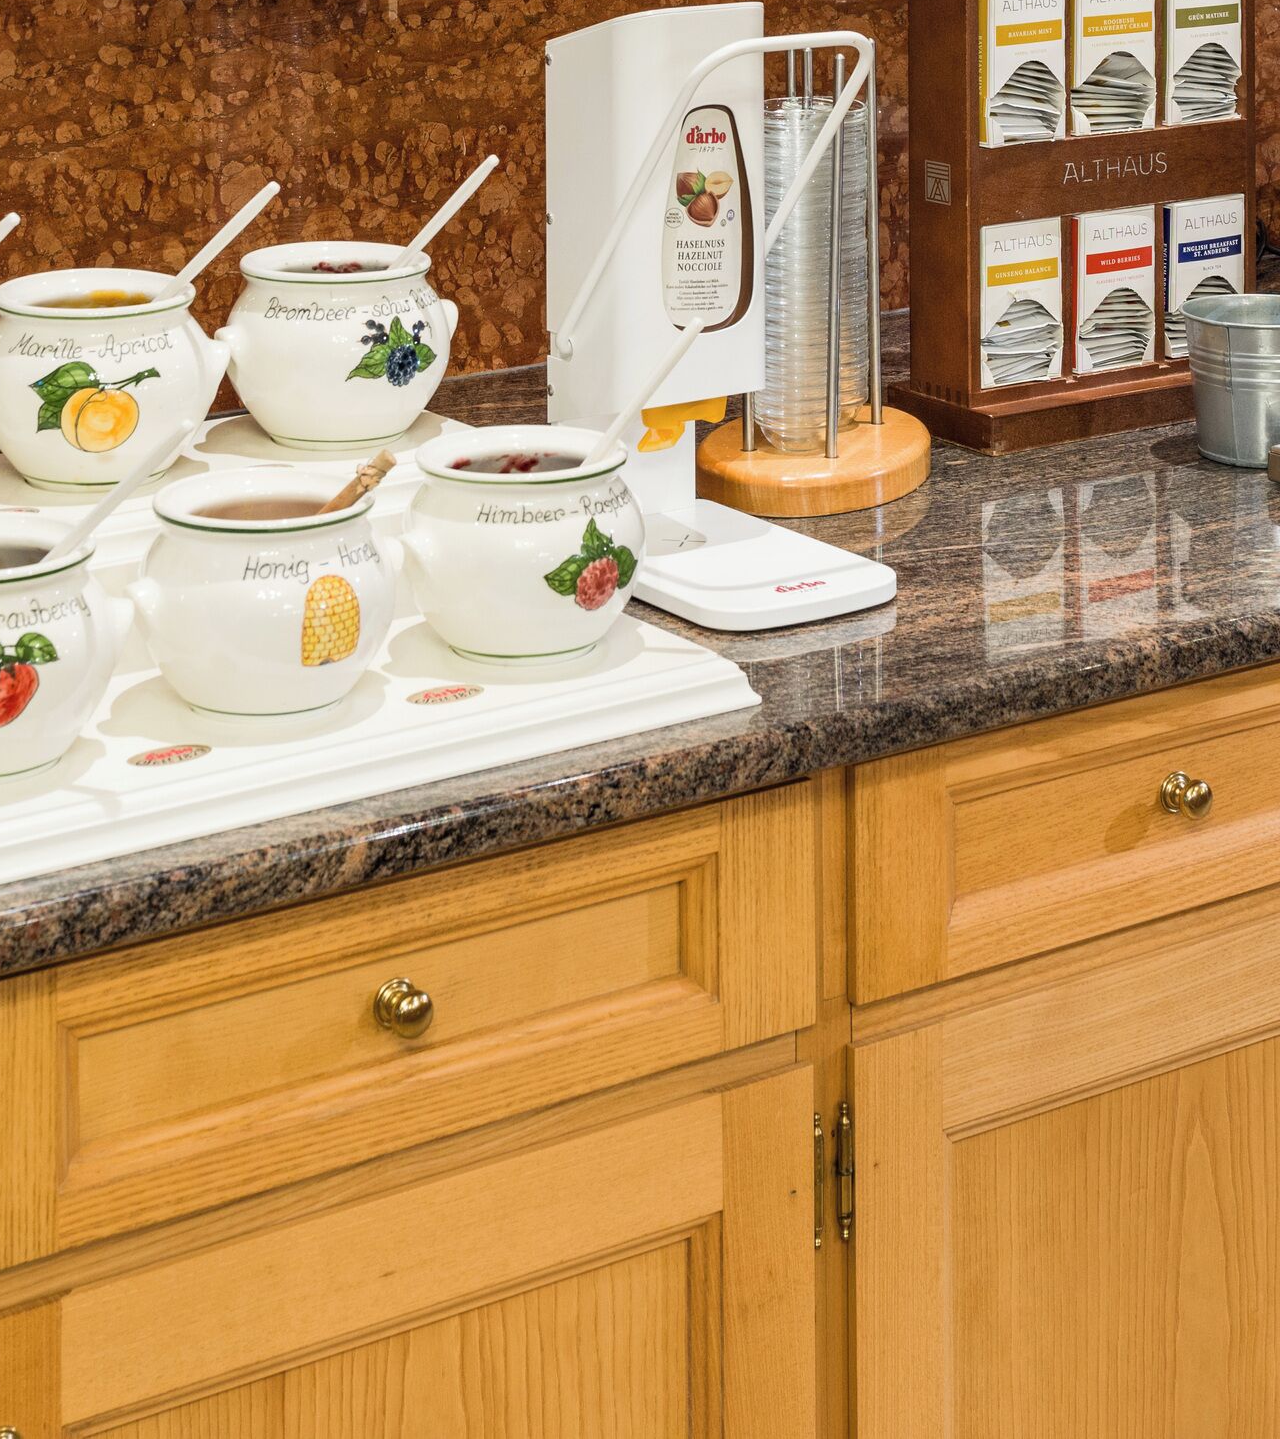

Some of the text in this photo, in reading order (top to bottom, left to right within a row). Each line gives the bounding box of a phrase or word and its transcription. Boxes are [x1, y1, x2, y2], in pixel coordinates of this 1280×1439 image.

[1205, 11, 1229, 19] MATINEE
[1038, 28, 1053, 36] MINT
[1087, 24, 1127, 32] STRAWBERRY
[1063, 152, 1168, 185] ALTHAUS
[1184, 212, 1238, 230] ALTHAUS
[1092, 222, 1148, 241] ALTHAUS
[676, 239, 725, 249] HASELNUSS
[993, 233, 1053, 253] ALTHAUS
[1183, 239, 1239, 253] ENGLISH BREAKFAST
[677, 251, 723, 260] HAZELNUT
[1204, 247, 1230, 256] ANDREWS
[677, 262, 722, 271] NOCCIOLE
[1100, 255, 1141, 266] WILD BERRIES
[995, 266, 1052, 279] GINSENG BALANCE
[264, 296, 355, 321] Brombeer
[8, 332, 82, 359] Marille
[98, 329, 173, 363] Apricot
[477, 502, 565, 524] Himbeer
[243, 554, 310, 584] Honig
